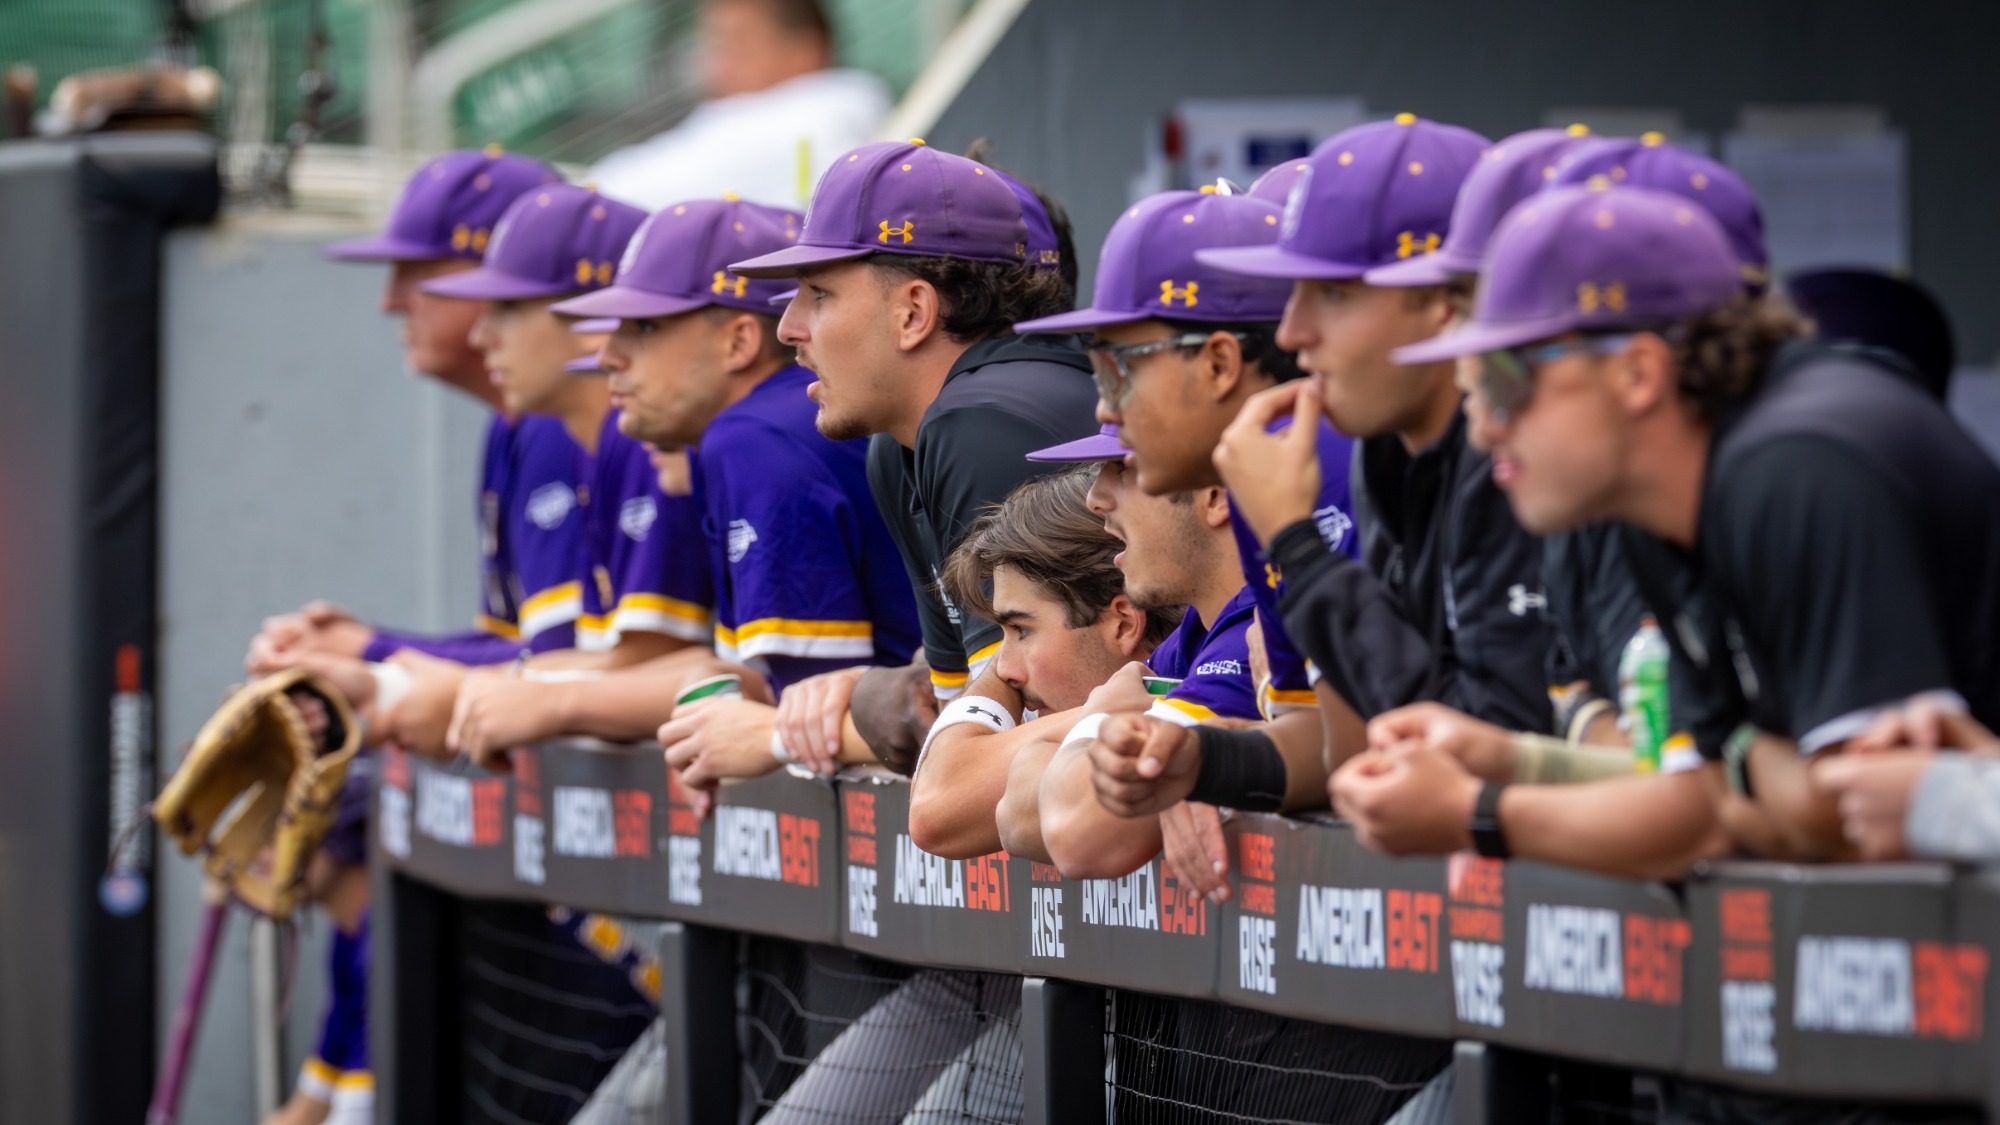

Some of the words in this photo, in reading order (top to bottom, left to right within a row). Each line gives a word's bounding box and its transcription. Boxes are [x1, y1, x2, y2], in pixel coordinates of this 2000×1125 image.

[713, 803, 783, 882] AMERICA
[779, 813, 821, 888] EAST
[894, 833, 965, 908] AMERICA
[966, 850, 1010, 912] EAST
[848, 864, 879, 938] RISE
[1031, 887, 1065, 959] RISE
[1082, 859, 1159, 931] AMERICA
[1296, 884, 1385, 970] AMERICA
[1387, 889, 1443, 975] EAST
[1239, 915, 1276, 995] RISE
[1450, 940, 1505, 1028] RISE
[1523, 903, 1625, 999] AMERICA
[1624, 913, 1692, 1007] EAST
[1793, 934, 1914, 1037] AMERICA
